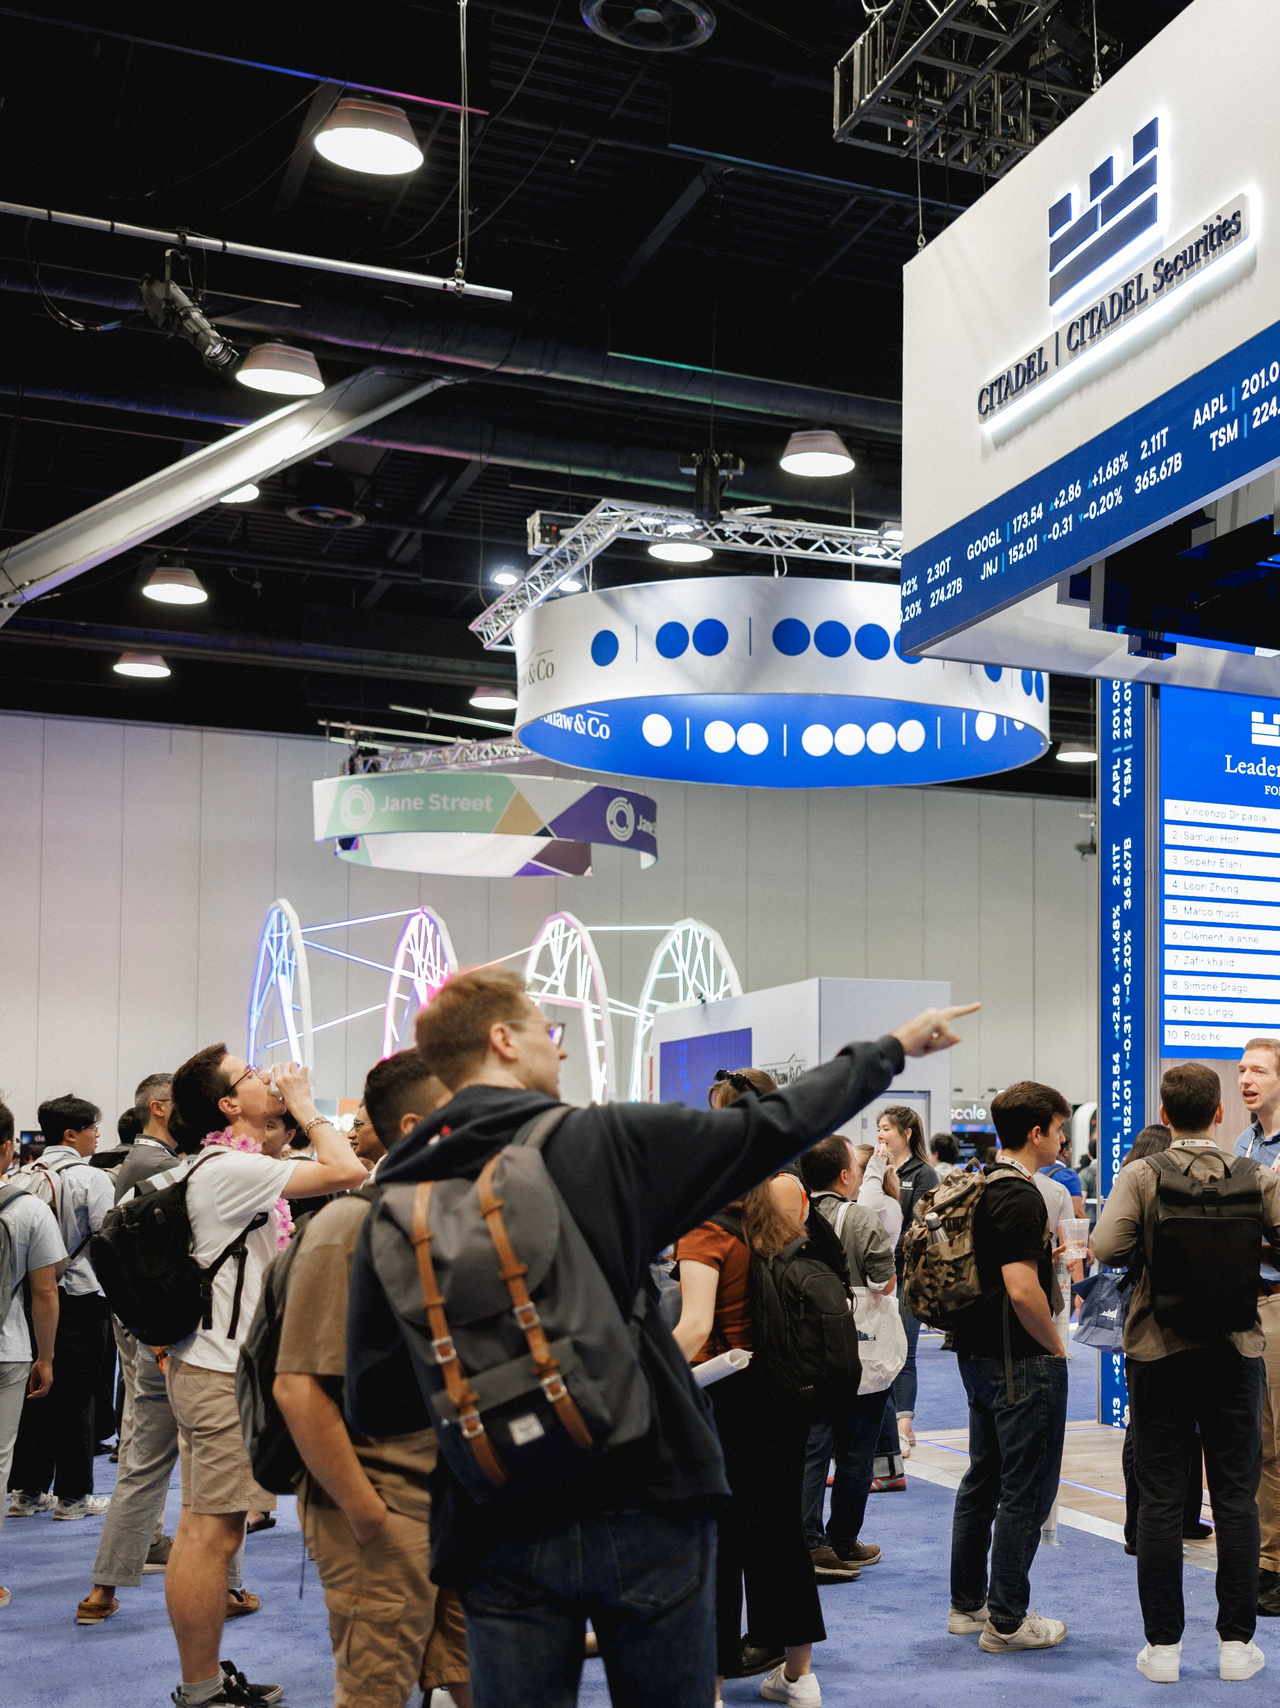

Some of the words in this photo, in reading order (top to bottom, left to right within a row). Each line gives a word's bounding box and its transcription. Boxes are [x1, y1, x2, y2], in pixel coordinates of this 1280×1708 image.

[977, 346, 1049, 416] CITADEL
[1066, 272, 1149, 352] CITADEL
[1152, 209, 1242, 294] Securities
[927, 556, 951, 585] 2.30T
[967, 528, 1002, 561] GOOGL
[1012, 502, 1043, 535] 173.54
[1054, 480, 1081, 508] +2.86
[1092, 451, 1129, 487] +1.68%
[1140, 426, 1169, 461] 2.11T
[1193, 393, 1228, 430] AAPL
[929, 576, 963, 609] 274.27B
[981, 557, 997, 580] JNJ
[1008, 534, 1038, 565] 152.01
[1048, 514, 1072, 539] -0.31
[1083, 486, 1123, 520] -0.20%
[1135, 452, 1183, 494] 365.67B
[1209, 418, 1239, 452] TSM
[587, 716, 610, 740] Co
[380, 796, 423, 813] Jane
[429, 793, 494, 813] Street
[1183, 831, 1217, 842] Samuel
[1183, 905, 1213, 916] Marco
[1183, 929, 1223, 941] Clement
[1183, 980, 1218, 991] Simone
[1183, 1005, 1206, 1015] Nico
[1208, 1006, 1234, 1018] Lingg
[1167, 1029, 1178, 1038] 10
[1183, 1029, 1206, 1039] Rose
[1209, 1030, 1221, 1039] he
[950, 1103, 987, 1120] scale
